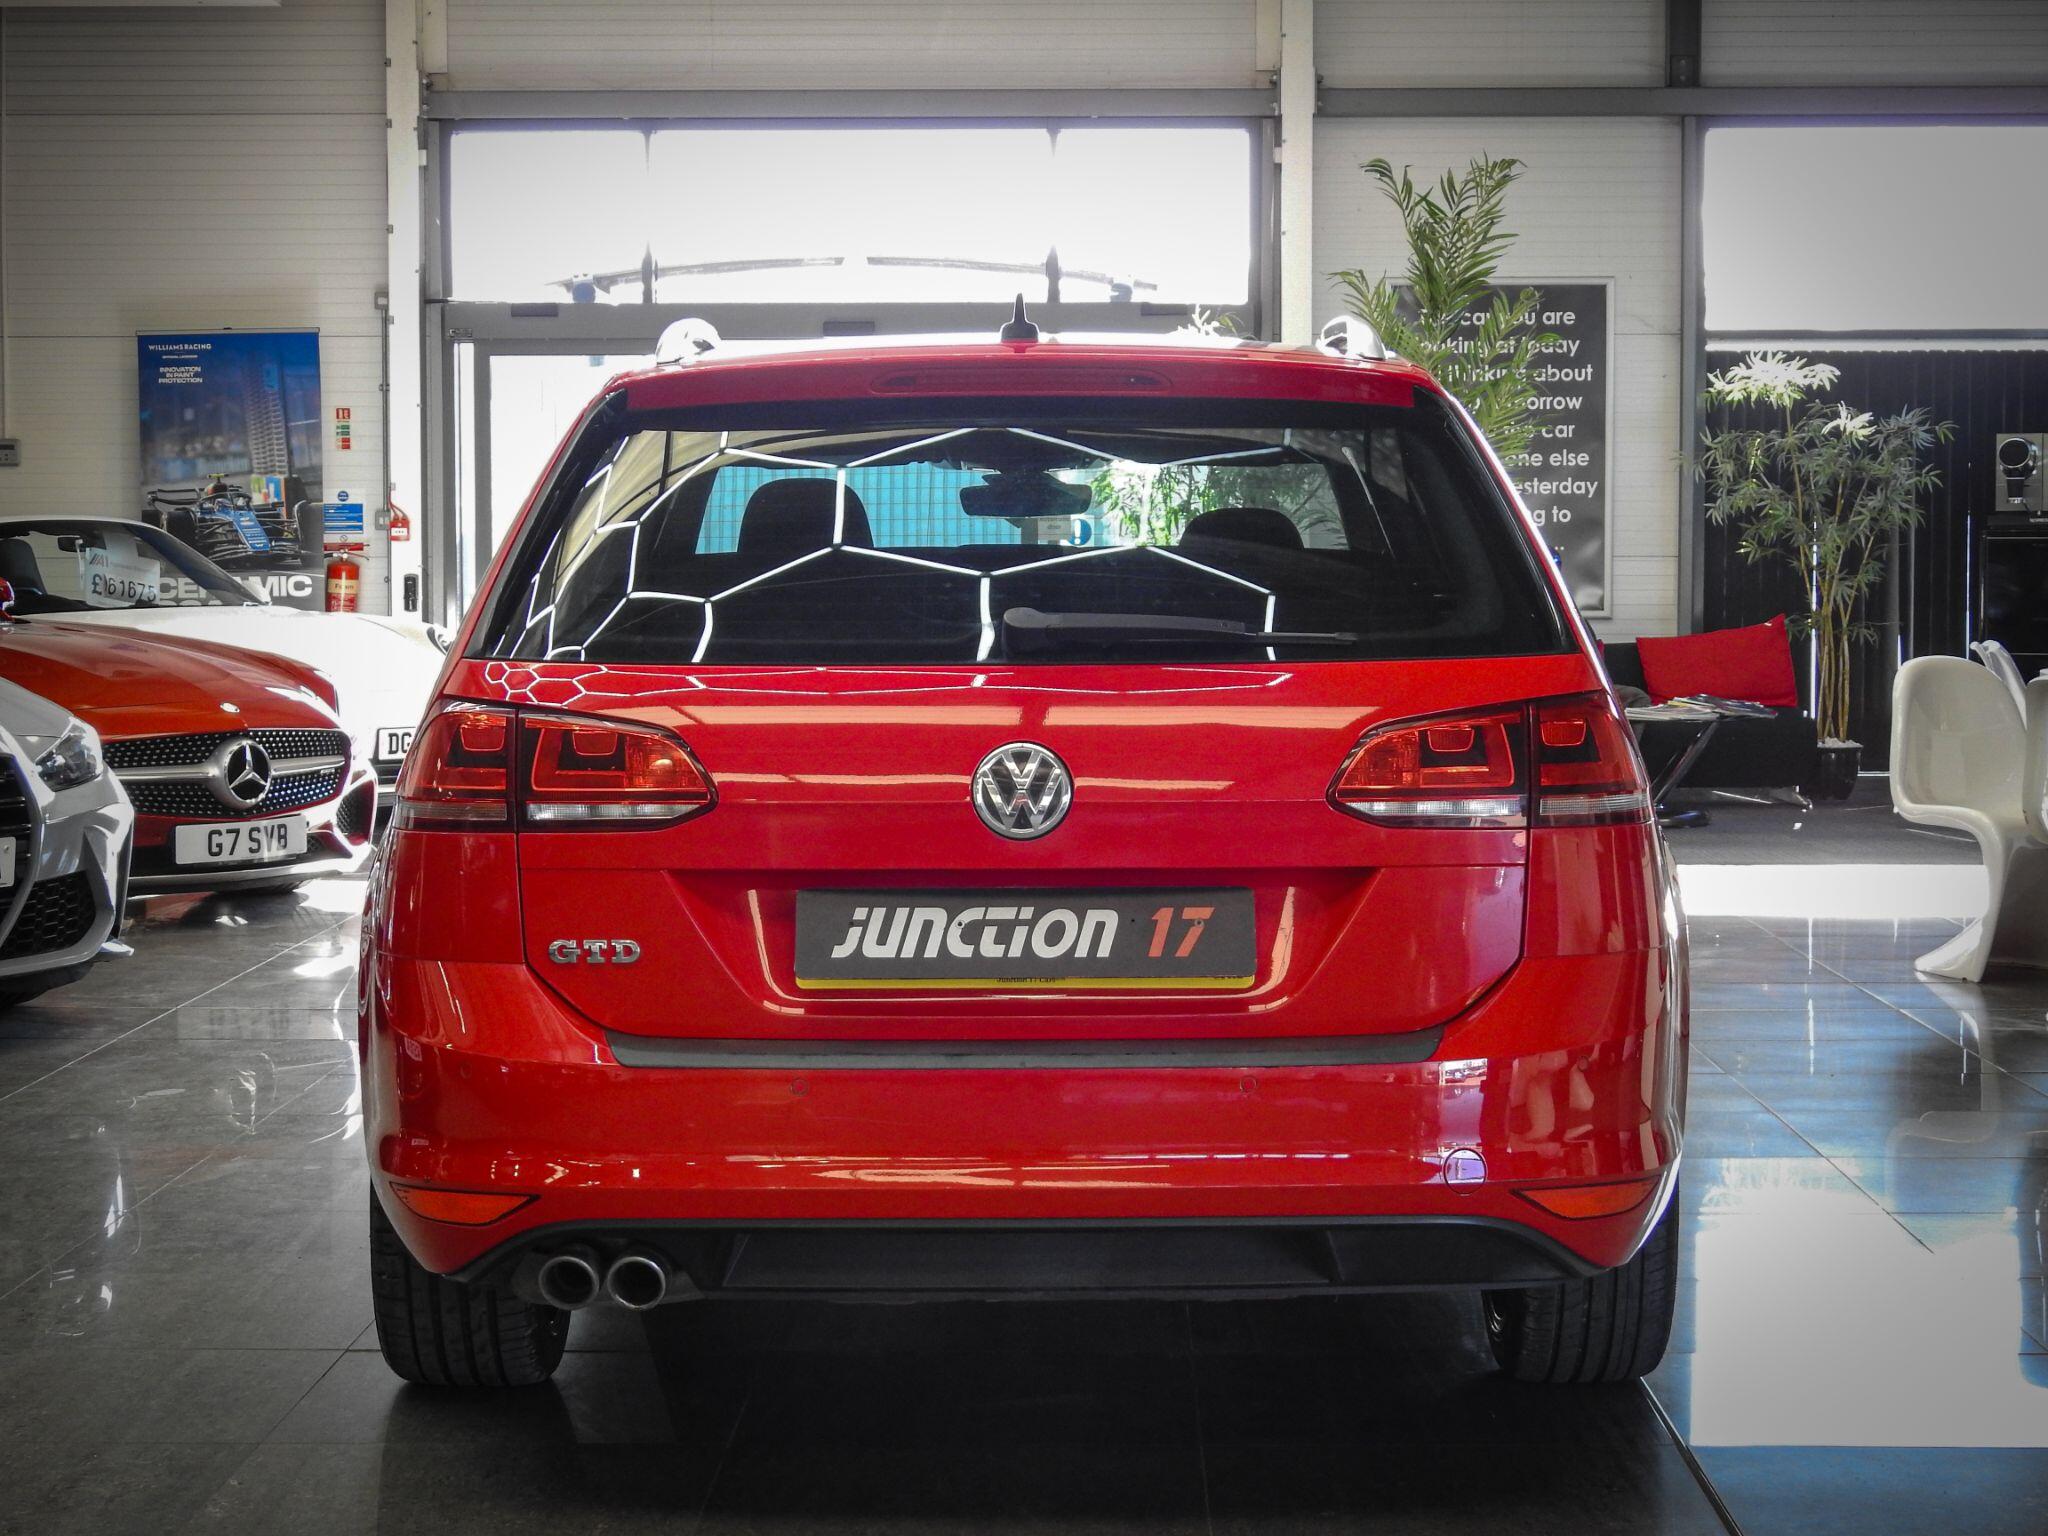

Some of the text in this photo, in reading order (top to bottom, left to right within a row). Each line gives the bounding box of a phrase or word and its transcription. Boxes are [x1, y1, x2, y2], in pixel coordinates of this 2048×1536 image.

[1542, 311, 1576, 325] are
[1535, 364, 1593, 382] about
[1549, 449, 1590, 466] else
[1515, 477, 1598, 498] esterday
[1552, 506, 1572, 523] to
[207, 823, 288, 857] G7 SVB
[1147, 906, 1216, 958] 17
[549, 940, 640, 963] GTD
